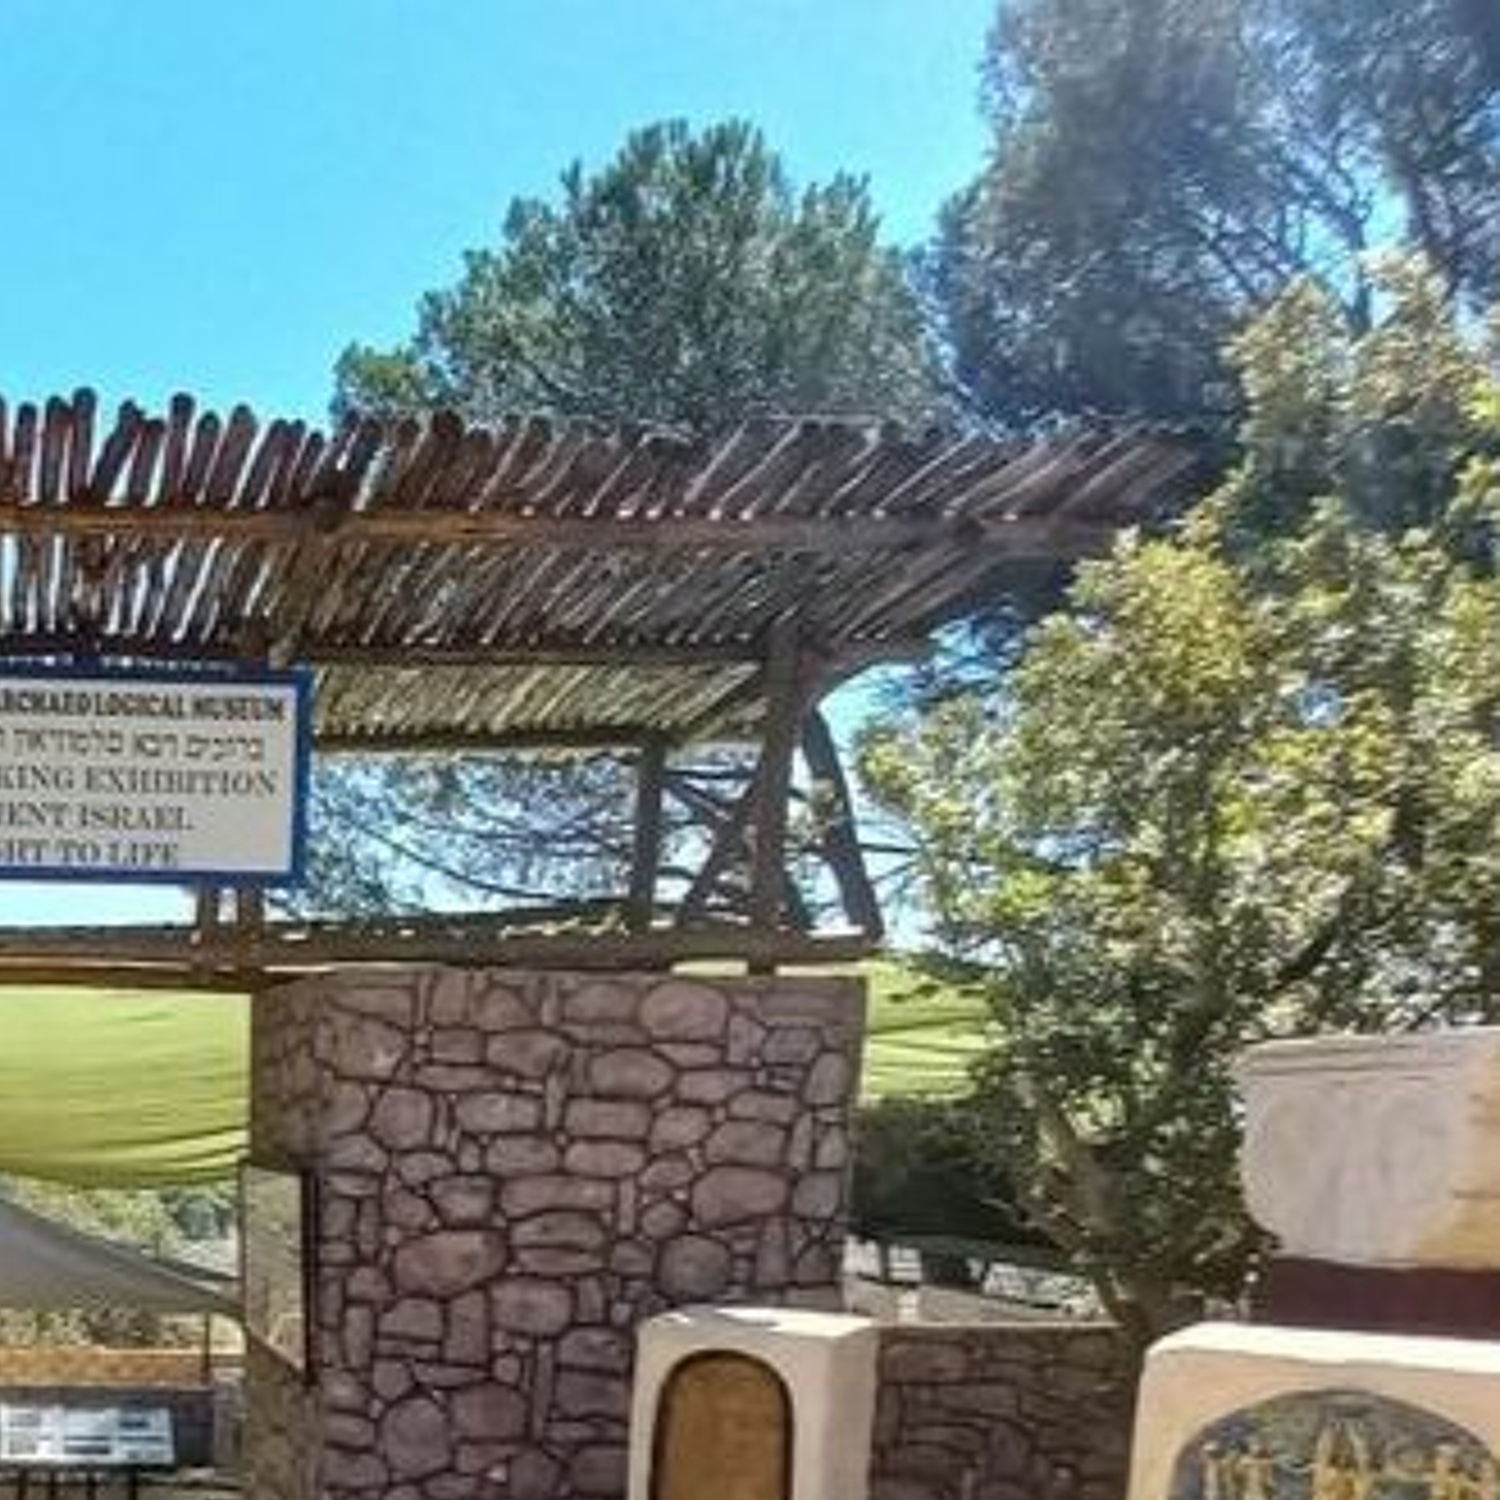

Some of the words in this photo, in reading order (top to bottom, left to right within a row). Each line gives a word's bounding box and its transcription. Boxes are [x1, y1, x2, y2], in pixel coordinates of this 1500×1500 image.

[191, 695, 286, 722] MUSEUM
[85, 765, 279, 797] EXHIBITION
[80, 804, 195, 831] ISRAEL
[53, 838, 102, 864] TO
[107, 841, 180, 867] LIFE
